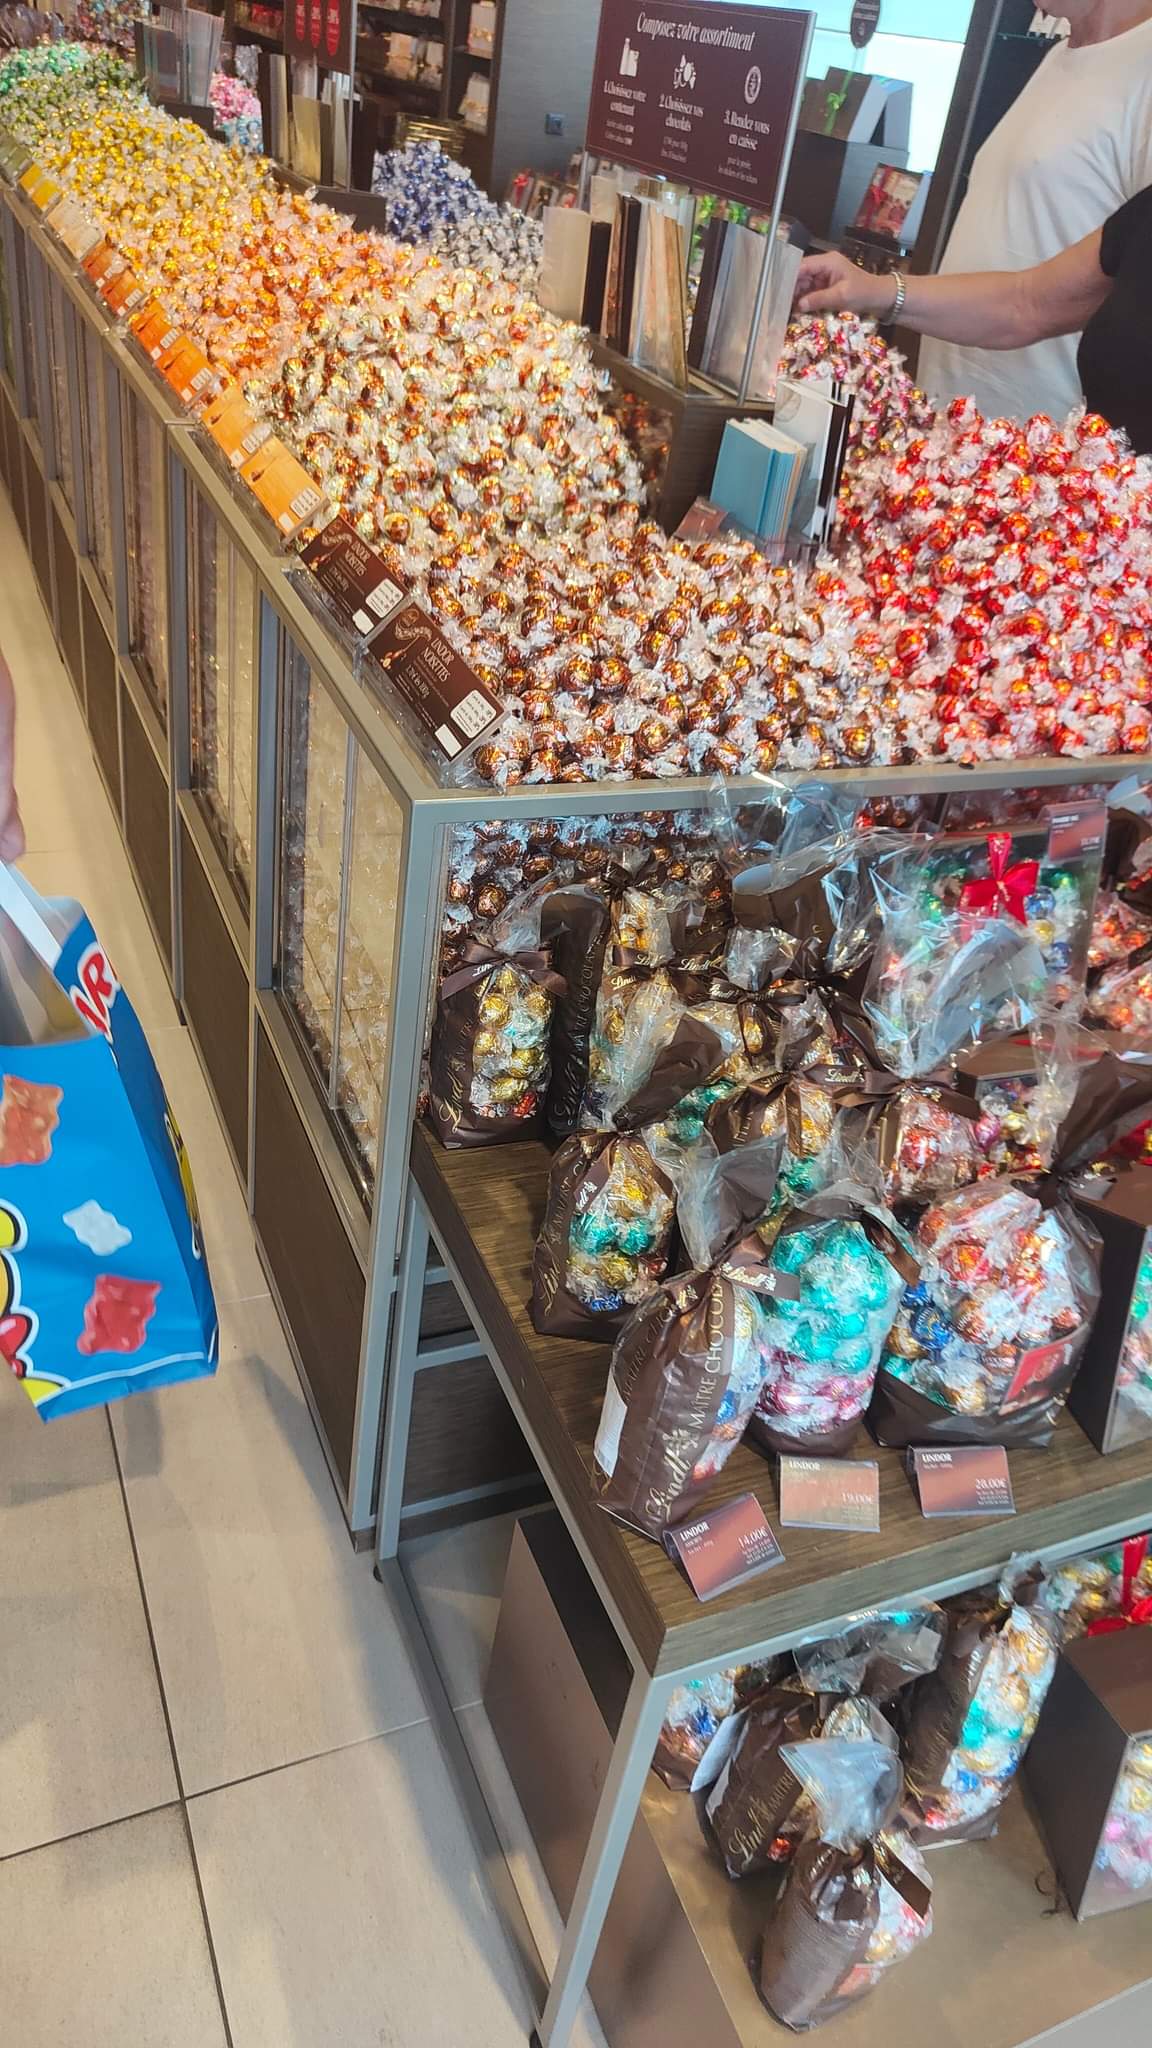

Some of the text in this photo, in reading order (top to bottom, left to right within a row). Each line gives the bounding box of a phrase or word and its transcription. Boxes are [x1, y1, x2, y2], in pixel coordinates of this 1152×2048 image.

[637, 12, 755, 51] Composez votre assortiment
[424, 647, 450, 682] NOISETTES
[431, 638, 454, 665] LINDOR
[646, 1447, 692, 1523] Lindt
[688, 1376, 718, 1429] MAÎTRE
[921, 1451, 952, 1463] LINDOR
[789, 1460, 820, 1471] LINDOR
[680, 1521, 710, 1542] LINDOR
[728, 1806, 767, 1869] Lindt
